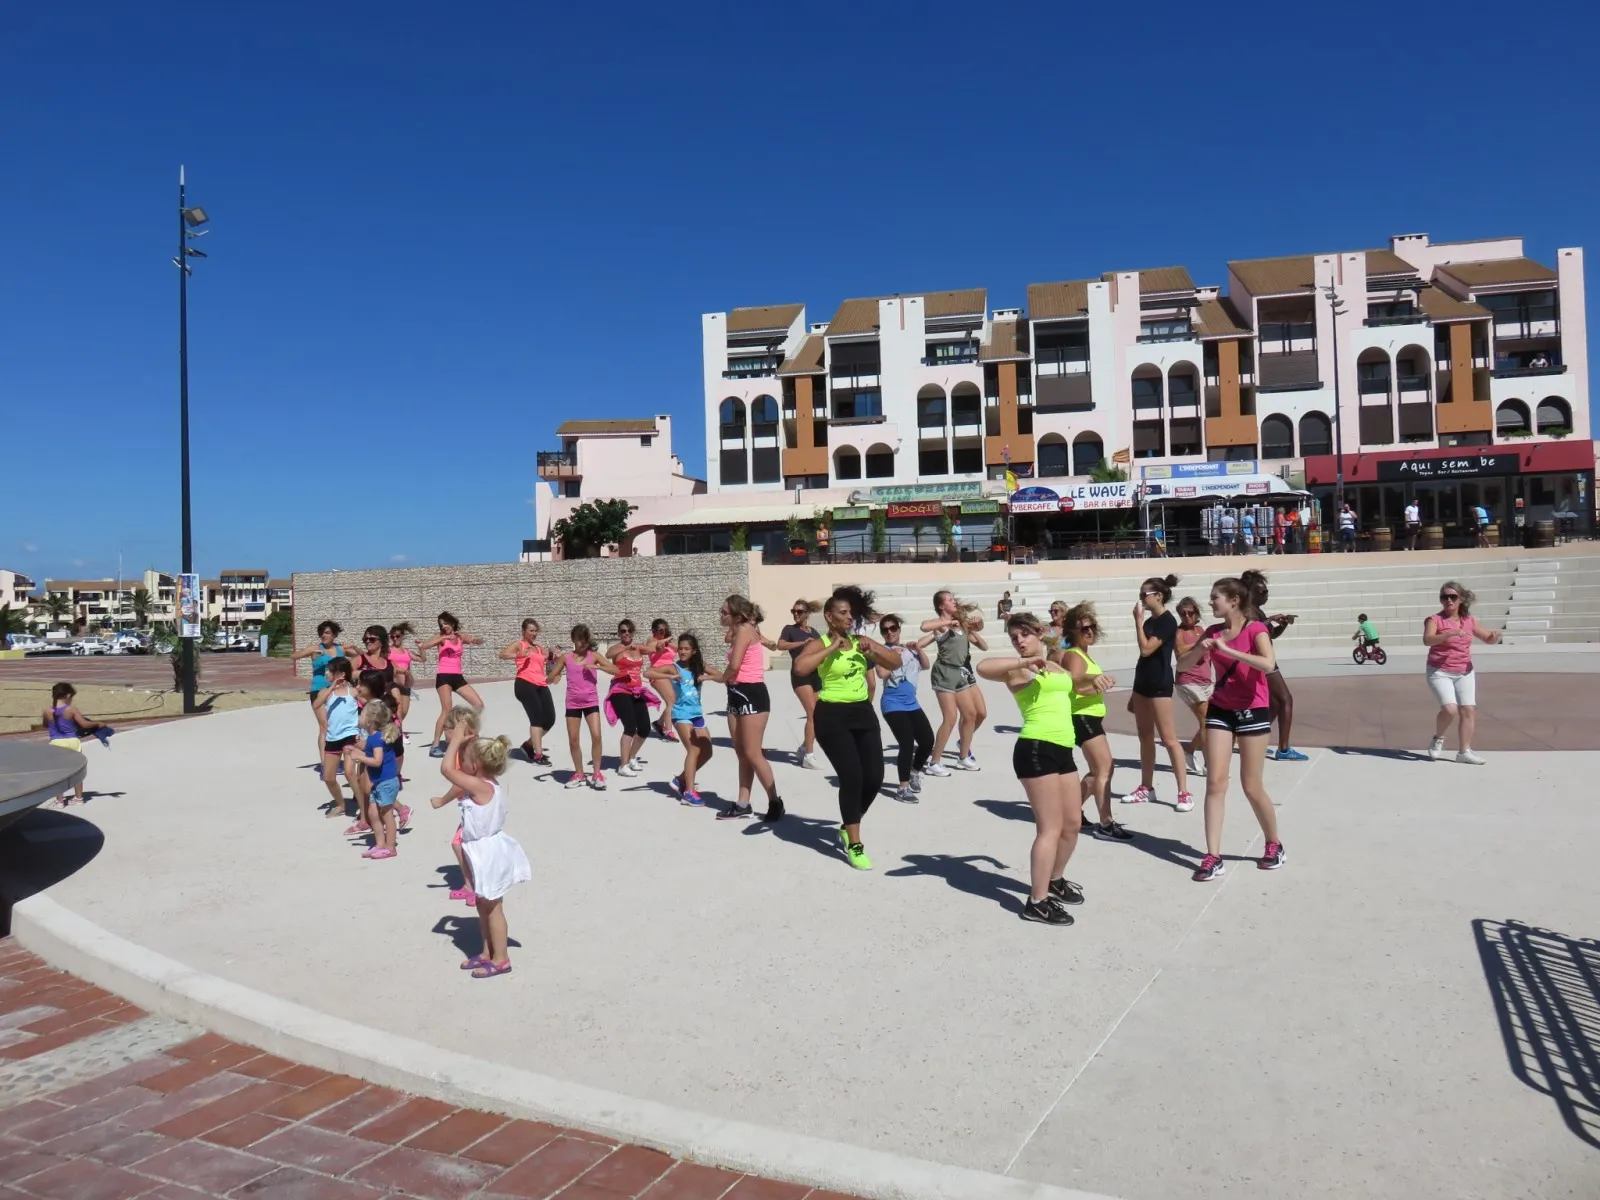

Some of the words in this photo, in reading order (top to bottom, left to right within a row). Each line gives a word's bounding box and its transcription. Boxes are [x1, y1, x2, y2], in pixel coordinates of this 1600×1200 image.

[1441, 460, 1469, 469] sem
[1480, 456, 1495, 467] be
[1070, 487, 1085, 498] LE
[1090, 485, 1127, 498] WAVE
[892, 504, 939, 515] BOOGIE
[1236, 709, 1253, 720] 22
